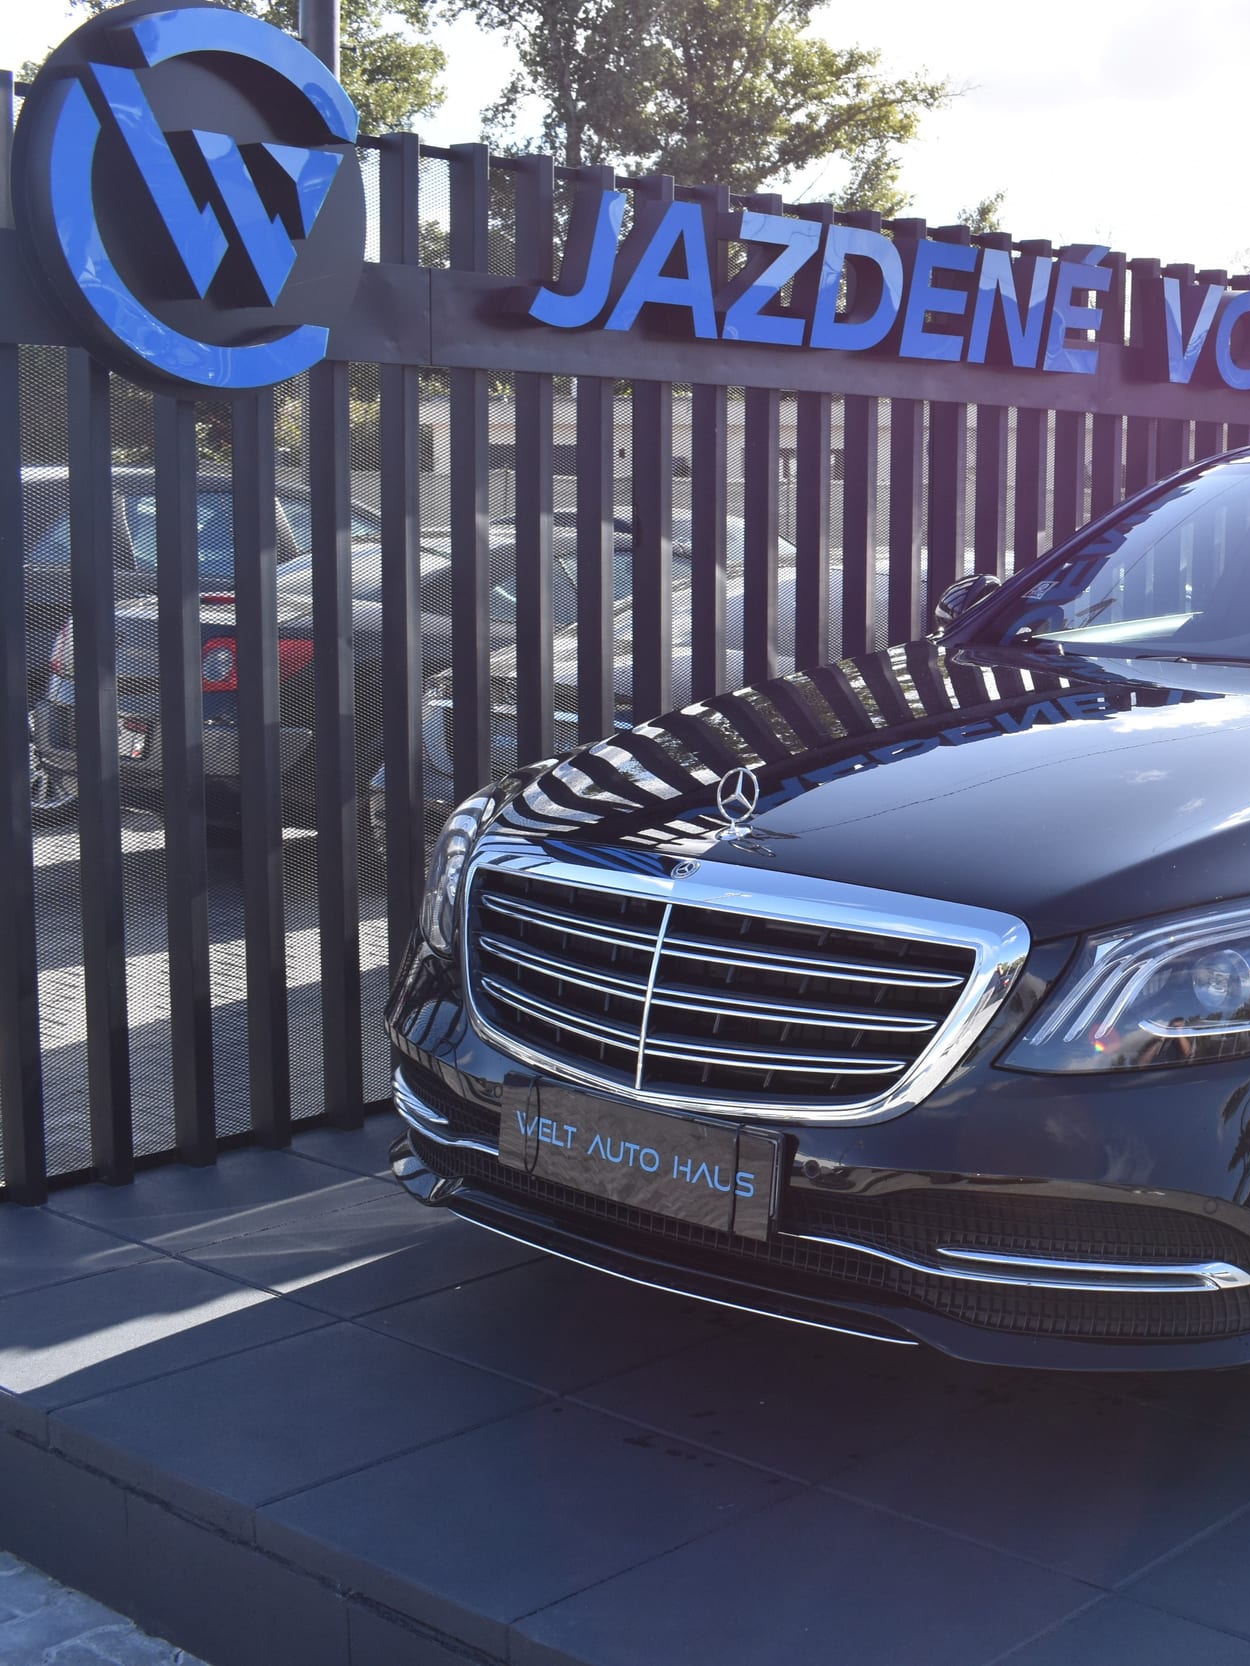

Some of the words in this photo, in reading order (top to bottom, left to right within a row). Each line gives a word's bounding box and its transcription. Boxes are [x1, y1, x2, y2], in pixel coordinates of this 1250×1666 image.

[529, 190, 1112, 374] JAZDENÉ
[516, 1110, 577, 1149] WELT
[587, 1135, 660, 1172] AUTO
[672, 1156, 755, 1198] HAUS
